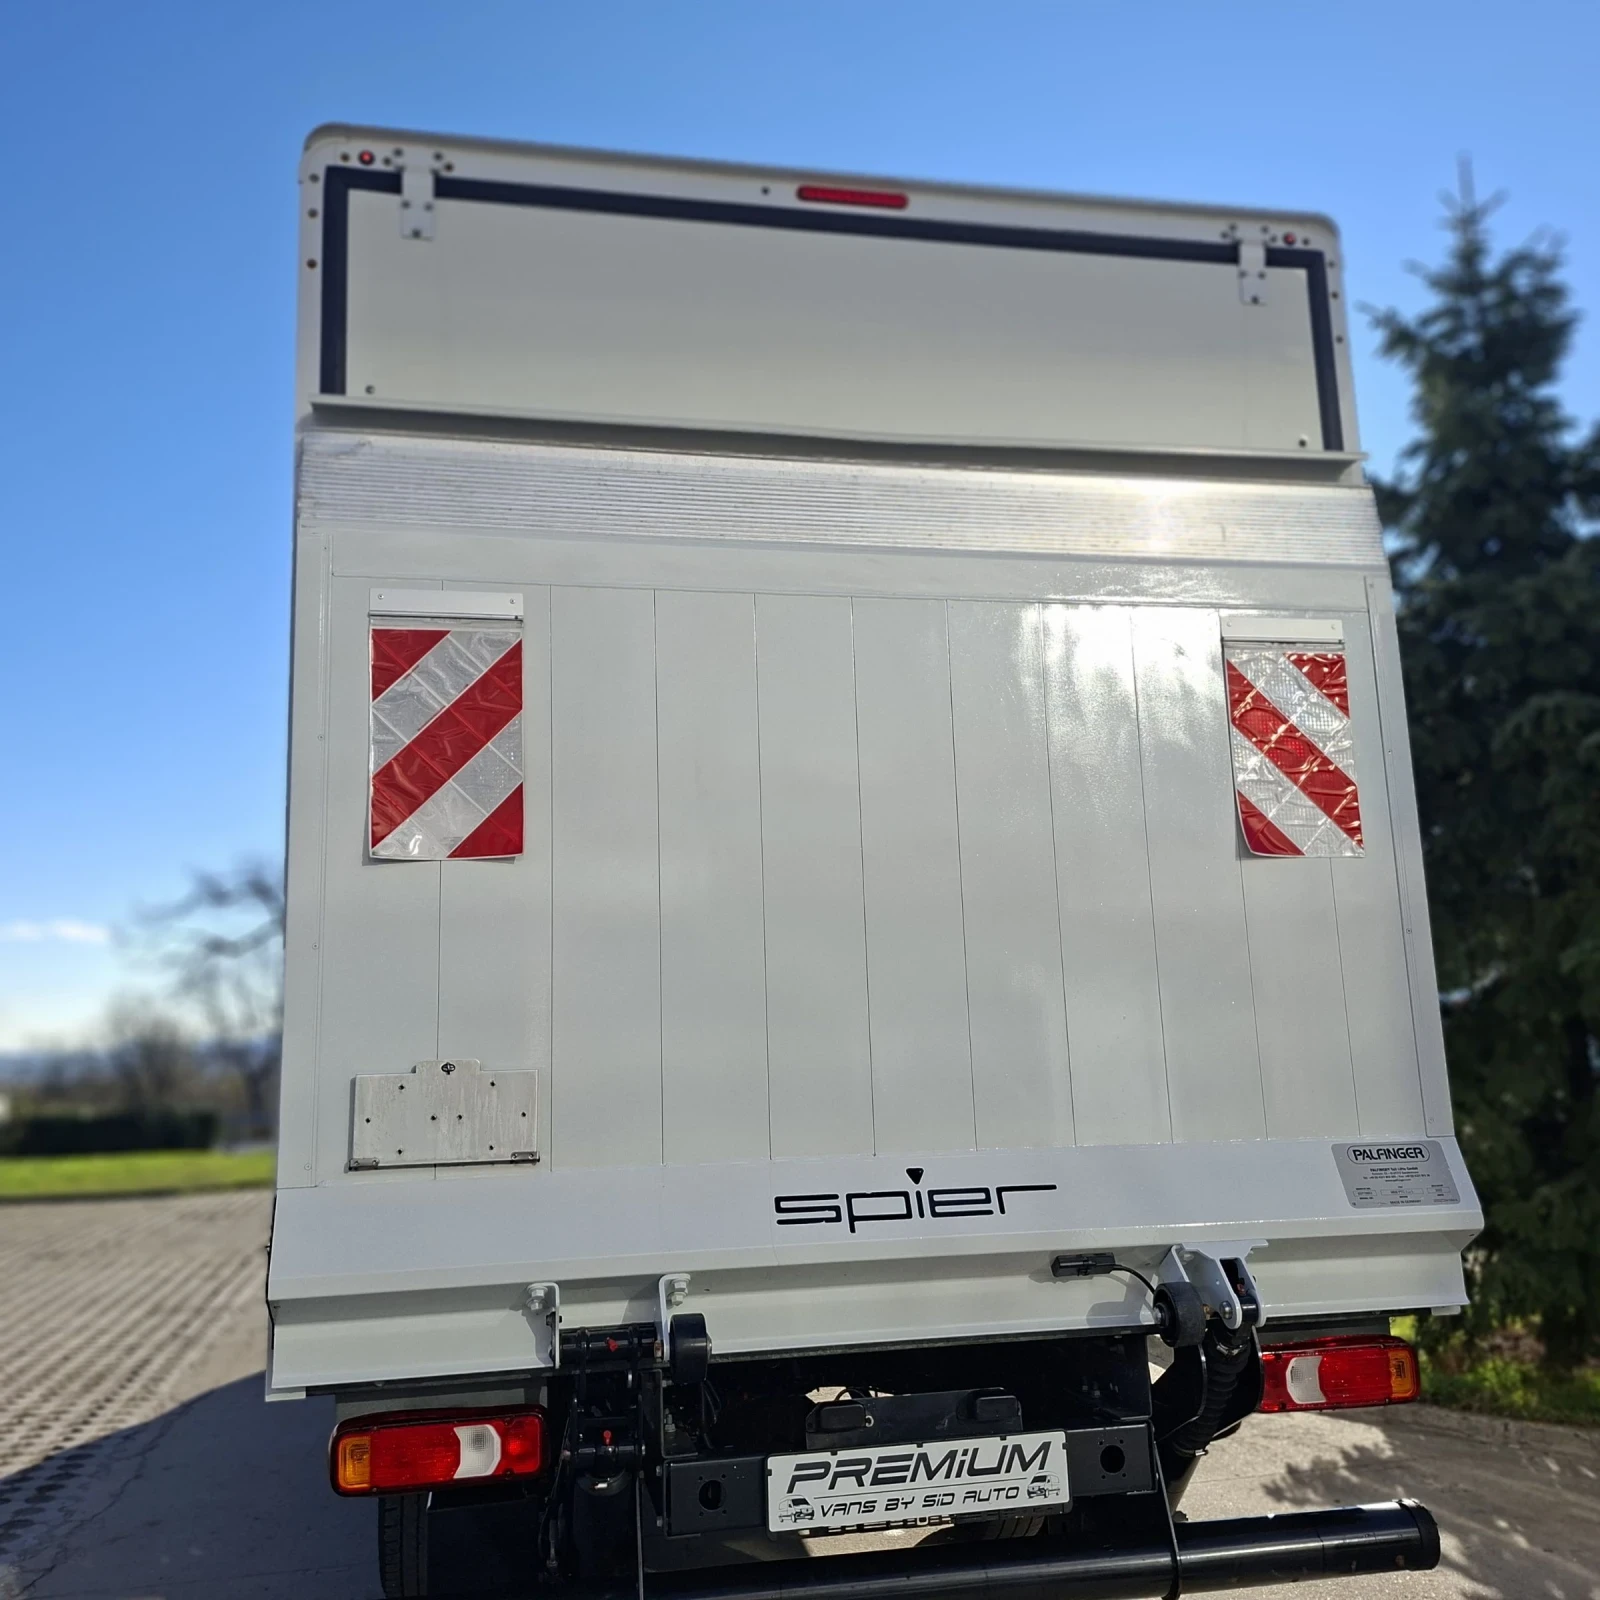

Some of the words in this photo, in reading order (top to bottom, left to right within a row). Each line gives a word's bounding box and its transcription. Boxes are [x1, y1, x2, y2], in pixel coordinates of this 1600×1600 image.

[1352, 1147, 1425, 1161] PALFINGER
[775, 1167, 1057, 1233] spier
[885, 1496, 915, 1512] BY
[962, 1486, 1020, 1504] AUTO
